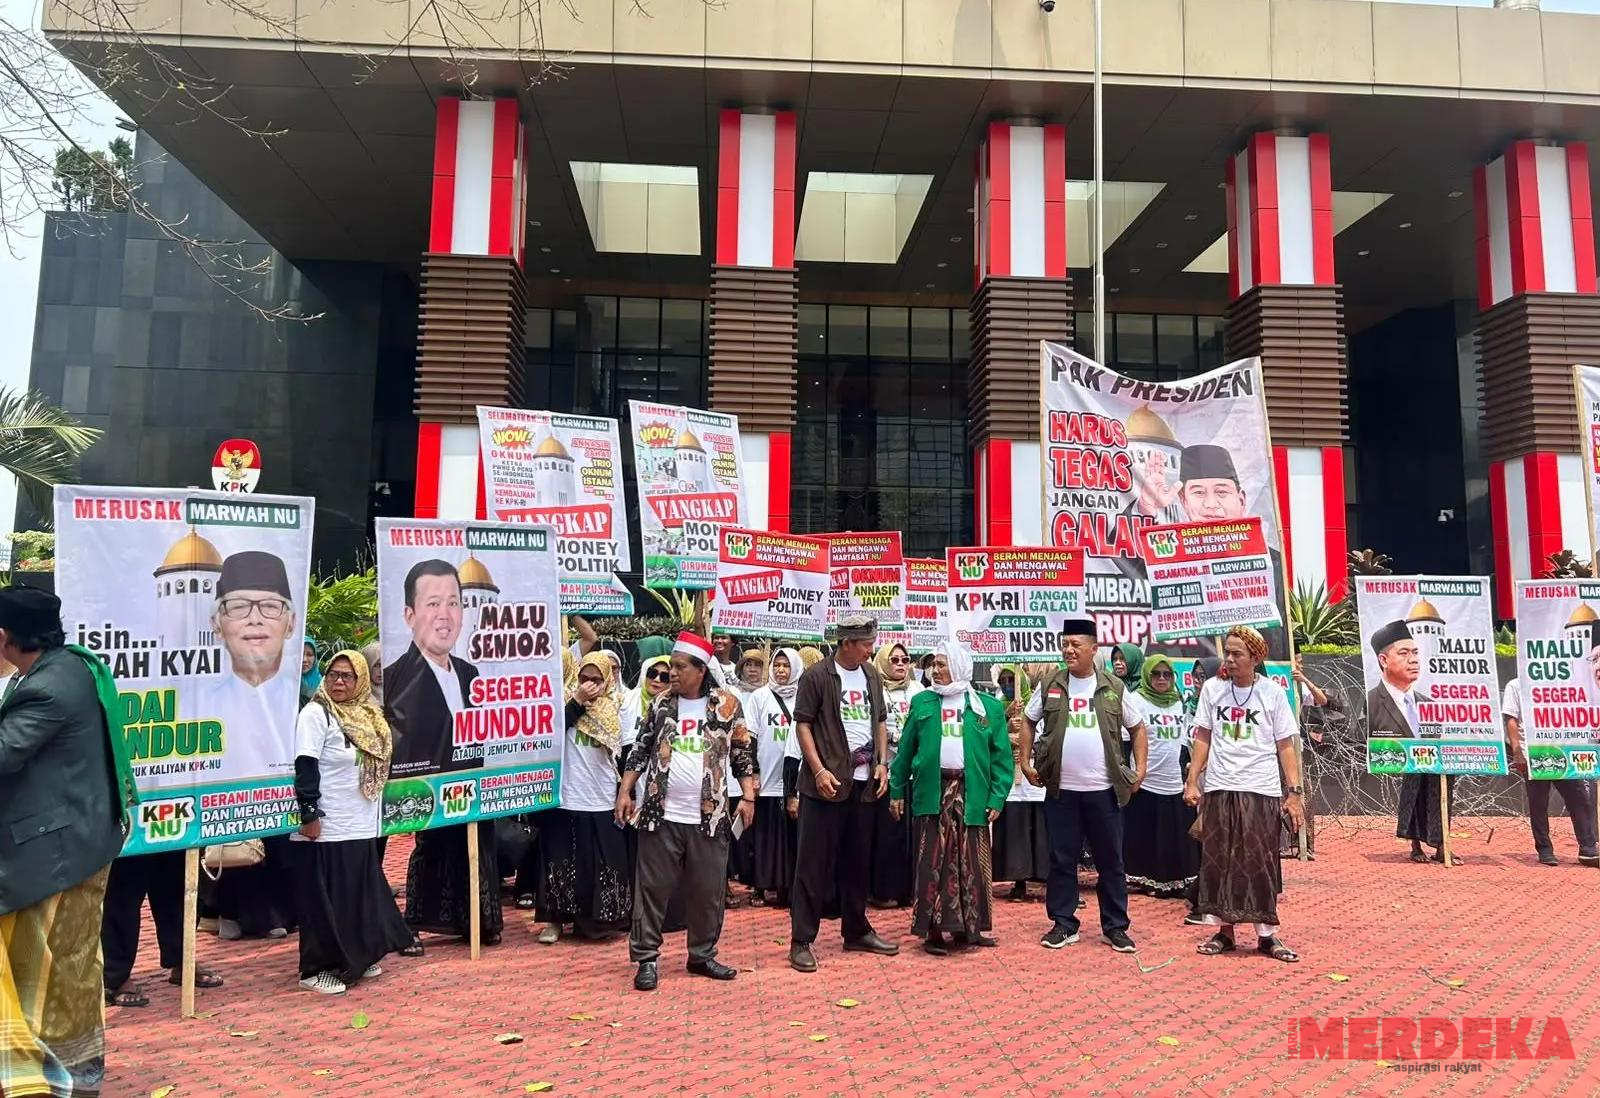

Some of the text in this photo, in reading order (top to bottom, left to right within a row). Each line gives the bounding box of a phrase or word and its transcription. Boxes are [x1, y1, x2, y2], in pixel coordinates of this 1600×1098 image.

[1051, 354, 1253, 403] PAK PRESIDEN
[553, 417, 608, 430] MARWAH NU
[1050, 410, 1127, 448] HARUS
[493, 429, 533, 445] WOW!
[640, 426, 674, 443] WOW!
[491, 450, 532, 460] OKNUM
[593, 459, 611, 468] TRIO
[1051, 447, 1133, 492] TEGAS
[582, 467, 612, 477] OKNUM
[219, 481, 249, 494] KPK
[583, 477, 613, 487] ISTANA
[495, 489, 535, 499] KEMBALIKAN
[1051, 492, 1119, 509] JANGAN
[75, 498, 296, 525] MERUSAK MARWAH NU
[656, 499, 734, 520] TANGKAP
[1181, 523, 1252, 537] BERANI MENJAGA
[390, 528, 545, 548] MERUSAK MARWAH NU
[727, 535, 750, 547] KPK
[756, 536, 820, 551] BERANI MENJAGA
[1149, 532, 1176, 545] KPK
[1183, 532, 1250, 546] DAN MENGAWAL
[557, 540, 619, 556] MONEY
[731, 545, 746, 556] NU
[756, 545, 817, 559] DAN MENGAWAL
[832, 545, 888, 553] DAN MENGAWAL
[1155, 543, 1174, 555] NU
[1185, 542, 1242, 555] MARTABAT NU
[756, 553, 808, 566] MARTABAT NU
[832, 553, 869, 561] MARTABAT
[958, 555, 986, 567] KPK
[993, 552, 1073, 561] BERANI MENJAGA
[681, 561, 717, 571] DIRUMAH
[911, 563, 938, 571] BERANI
[962, 566, 982, 578] NU
[994, 561, 1068, 570] DAN MENGAWAL
[1213, 560, 1266, 573] MARWAH NU
[851, 567, 901, 583] OKNUM
[994, 571, 1057, 580] MARTABAT NU
[1221, 576, 1267, 588] MENERIMA
[725, 576, 780, 598] TANGKAP
[854, 585, 900, 596] ANNASIR
[1365, 581, 1480, 594] MERUSAK MARWAH NU
[1525, 586, 1577, 599] MERUSAK
[779, 587, 824, 602] MONEY
[955, 592, 1020, 611] KPK-RI
[1029, 591, 1078, 601] JANGAN
[1207, 586, 1269, 603] UANG RISYWAH
[768, 600, 813, 615] POLITIK
[861, 597, 892, 607] JAHAT
[1029, 601, 1078, 613] GALAU
[480, 604, 546, 631] MALU
[719, 609, 753, 619] DIRUMAH
[1158, 610, 1195, 623] DIRUMAH
[718, 618, 752, 627] PUSAKA
[996, 618, 1042, 626] SEGERA
[1159, 621, 1198, 631] PUSAKA
[470, 631, 551, 660] SENIOR
[1438, 638, 1486, 655] MALU
[1526, 639, 1583, 659] MALU
[160, 648, 221, 677] KYAI
[1429, 657, 1490, 675] SENIOR
[1528, 661, 1571, 681] GUS
[471, 674, 553, 704] SEGERA
[1430, 684, 1490, 700] SEGERA
[1532, 686, 1587, 703] SEGERA
[1150, 714, 1184, 726] KPK
[1216, 705, 1260, 726] KPK
[1419, 704, 1492, 724] MUNDUR
[455, 704, 553, 744] MUNDUR
[1066, 714, 1097, 729] NU
[1157, 727, 1181, 739] NU
[1222, 723, 1252, 740] NU
[1445, 727, 1469, 735] JEMPUT
[1470, 727, 1495, 735] KPK-NU
[1564, 731, 1589, 739] JEMPUT
[452, 740, 552, 761] ATAU DI JEMPUT KPK-NU
[1412, 748, 1436, 757] KPK
[1441, 746, 1498, 755] BERANI MENJAGA
[1416, 756, 1433, 765] NU
[1458, 755, 1498, 763] MENGAWAL
[1572, 753, 1595, 763] KPK
[149, 759, 222, 776] KALIYAN KPK-NU
[1442, 762, 1486, 771] MARTABAT
[1577, 761, 1592, 771] NU
[480, 769, 554, 788] BERANI MENJAGA
[201, 785, 298, 808] BERANI MENJA
[442, 784, 474, 801] KPK
[480, 782, 553, 801] DAN MENGAWAL
[446, 798, 468, 814] NU
[480, 793, 553, 814] MARTABAT NU
[143, 801, 191, 823] KPK
[201, 808, 230, 823] DAN
[149, 820, 182, 839] NU
[201, 815, 283, 838] MARTABAT
